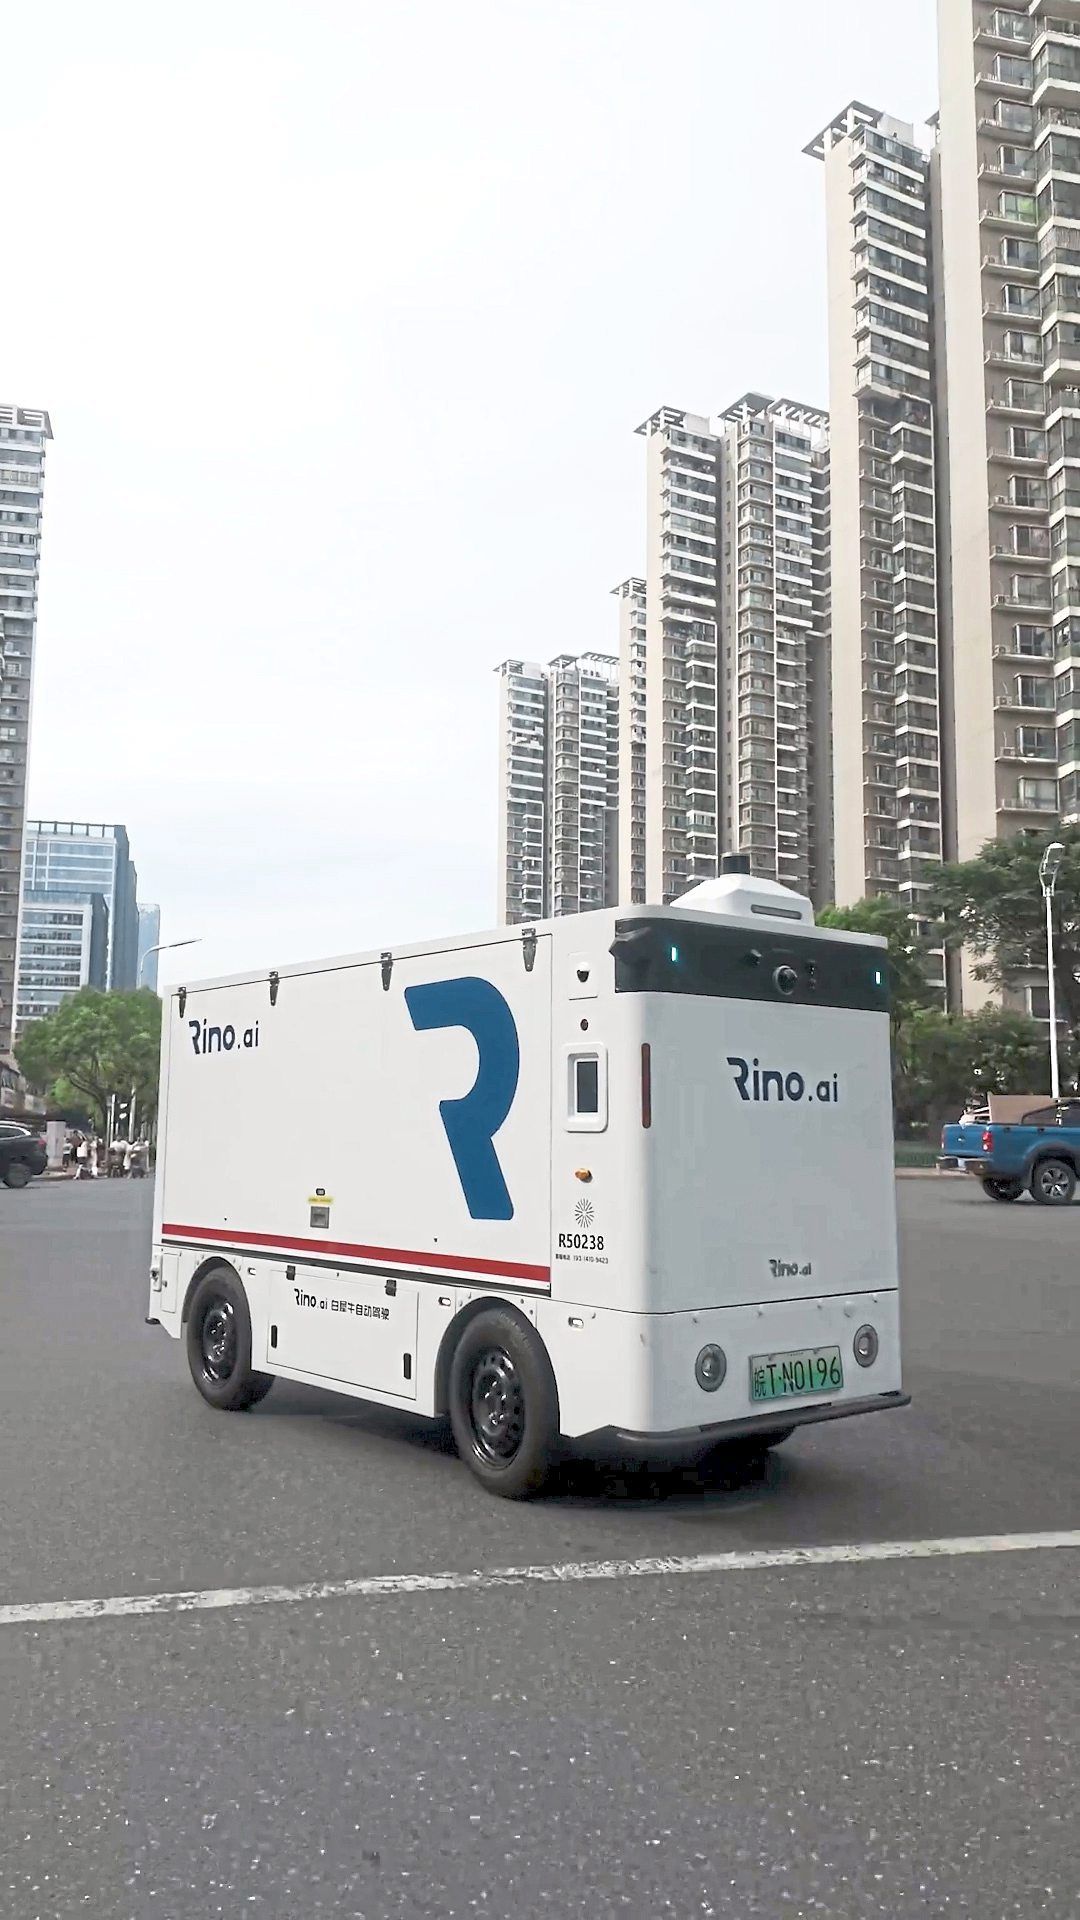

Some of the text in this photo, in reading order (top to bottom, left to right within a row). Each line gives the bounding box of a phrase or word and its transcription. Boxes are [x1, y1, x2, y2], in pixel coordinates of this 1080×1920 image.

[188, 1018, 259, 1055] Rino.ai
[726, 1057, 839, 1102] Rino.ai
[558, 1233, 604, 1251] R50238
[293, 1288, 328, 1310] Rino.ai
